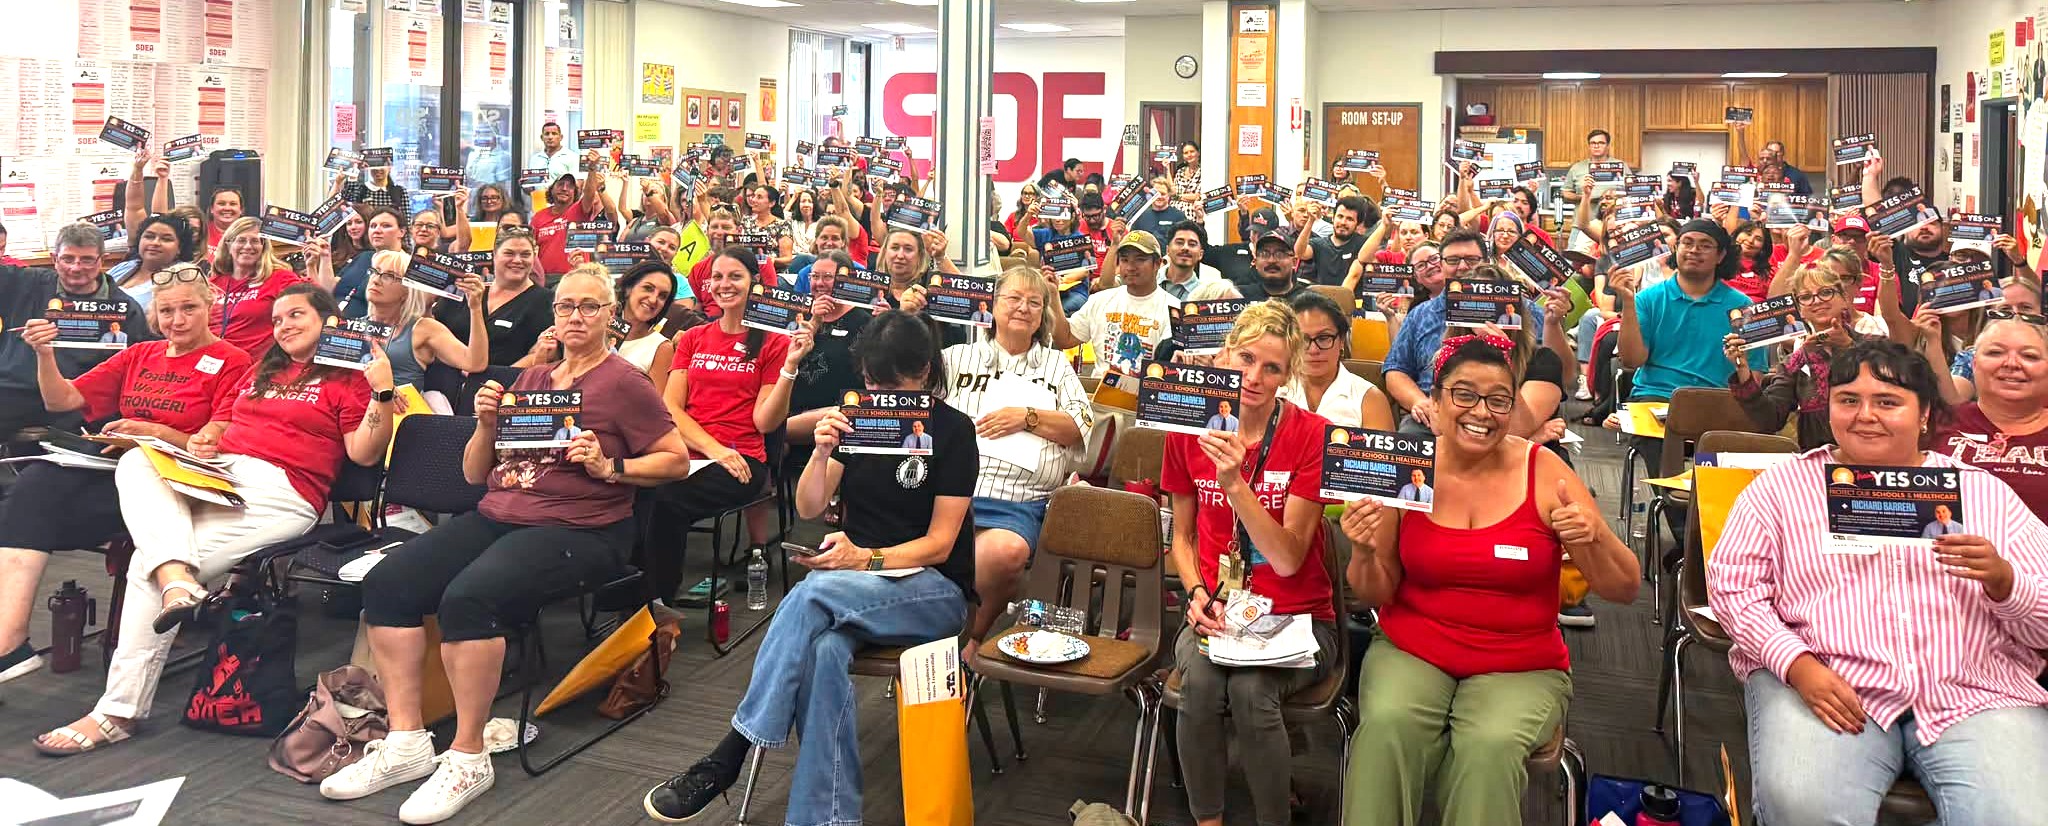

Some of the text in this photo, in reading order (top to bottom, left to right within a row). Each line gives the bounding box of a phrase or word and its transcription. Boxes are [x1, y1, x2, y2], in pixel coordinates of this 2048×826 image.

[135, 44, 154, 52] SDEA
[1341, 112, 1403, 125] ROOM SET-UP
[1120, 188, 1132, 199] YES
[1880, 187, 1920, 209] YES ON 3
[316, 205, 329, 215] YES
[335, 192, 342, 201] 3
[910, 196, 925, 207] YES
[925, 201, 934, 209] ON
[1789, 196, 1807, 204] YES
[1821, 198, 1829, 206] 3
[116, 209, 122, 218] 3
[285, 210, 300, 220] YES
[582, 222, 596, 230] YES
[1622, 224, 1659, 242] YES ON 3
[1058, 240, 1074, 248] YES
[1084, 236, 1090, 244] 3
[435, 252, 474, 273] YES ON 3
[486, 252, 492, 260] 3
[1541, 246, 1573, 277] YES ON 3
[1942, 261, 1991, 278] YES ON 3
[855, 270, 871, 280] YES
[883, 276, 890, 284] 3
[950, 278, 994, 292] YES ON 3
[1471, 284, 1519, 294] YES ON 3
[771, 288, 790, 301] YES
[804, 296, 813, 306] 3
[73, 300, 128, 312] YES ON 3
[1208, 303, 1246, 313] YES ON
[1748, 296, 1793, 314] YES ON 3
[1106, 312, 1122, 322] THE
[346, 320, 390, 336] YES ON 3
[622, 324, 630, 333] 3
[1121, 322, 1149, 337] GAME
[139, 368, 190, 384] Together
[1177, 368, 1239, 388] YES ON 3
[134, 382, 152, 392] We
[1175, 385, 1238, 398] SCHOOLS HEALTHCARE
[122, 395, 186, 413] TRONGER!
[526, 393, 581, 405] YES ON 3
[870, 394, 929, 408] YES ON 3
[1158, 392, 1180, 403] RICHARD
[1363, 433, 1394, 450] YES
[1397, 441, 1418, 452] ON
[1422, 441, 1434, 456] 3
[1361, 451, 1389, 460] SCHOOLS
[1396, 456, 1432, 467] HEALTHCARE
[1344, 459, 1397, 473] RICHARD BARRERA
[1872, 471, 1910, 487] YES
[1913, 475, 1937, 486] ON
[1943, 473, 1957, 489] 3
[1254, 483, 1269, 492] WE
[1852, 500, 1916, 512] RICHARD BARRERA
